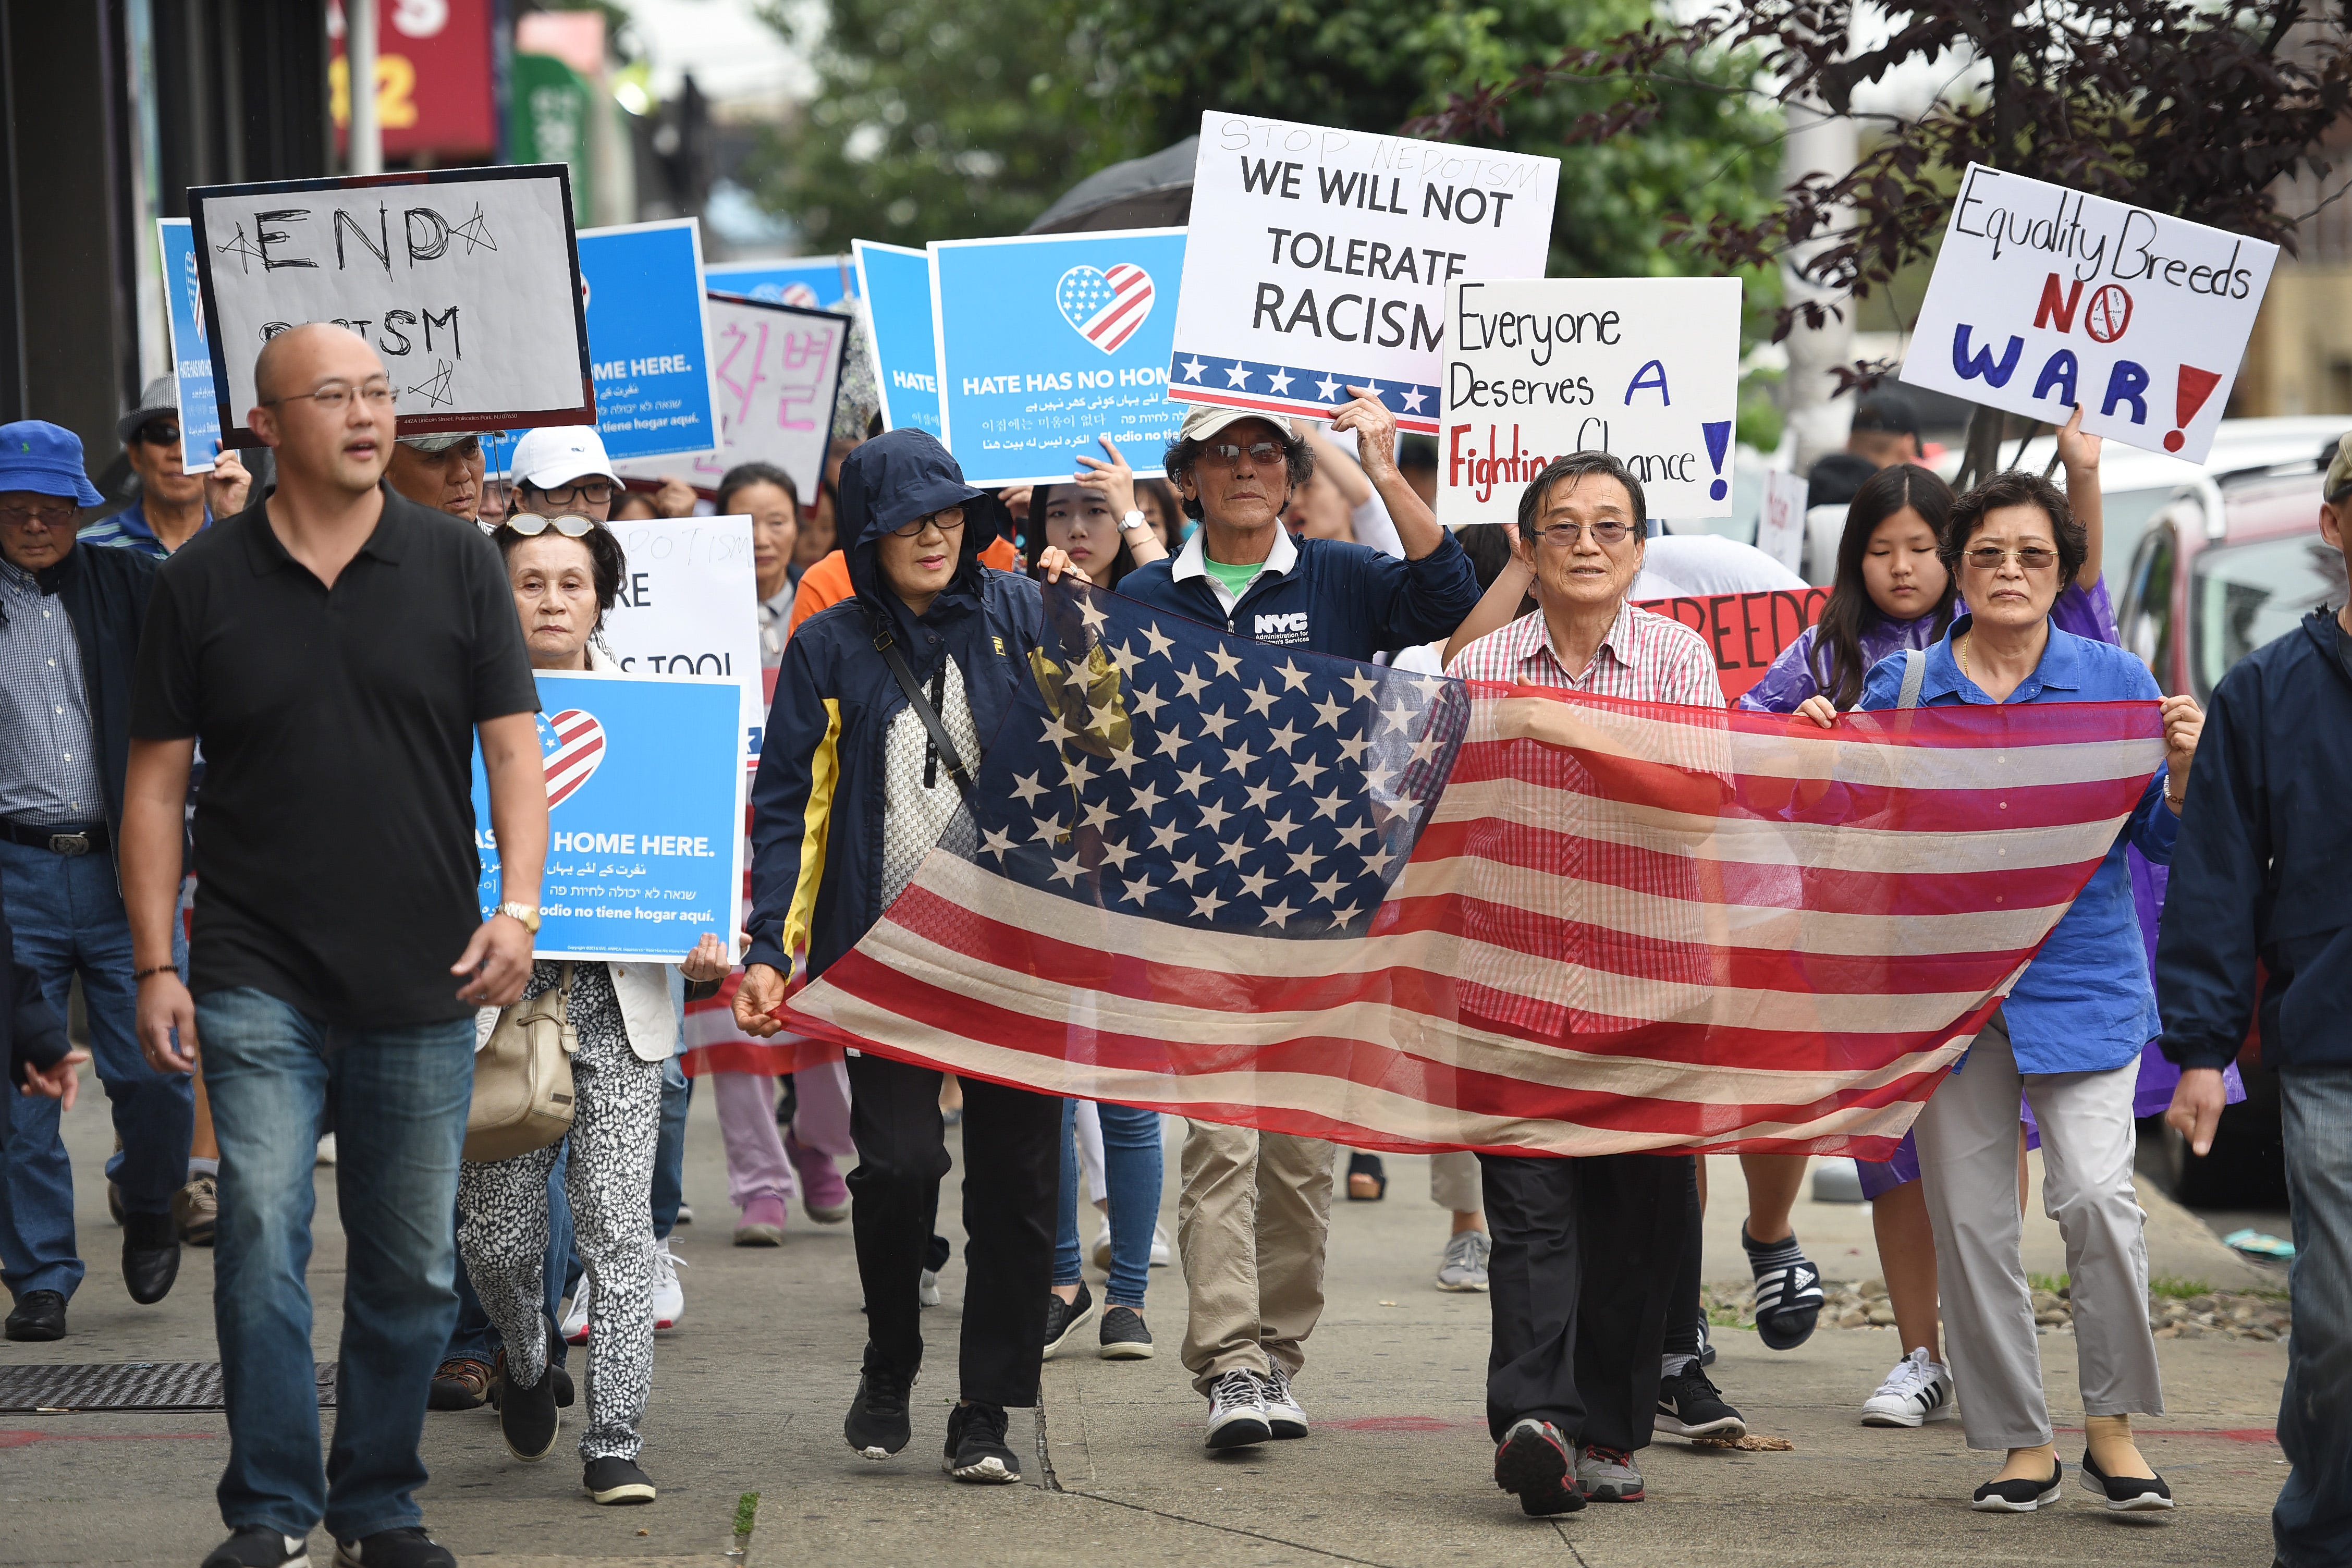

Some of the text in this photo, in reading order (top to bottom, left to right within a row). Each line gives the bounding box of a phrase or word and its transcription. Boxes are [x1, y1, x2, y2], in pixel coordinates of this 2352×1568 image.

[1221, 120, 1349, 163] STOP
[1241, 156, 1513, 228] WE WILL NOT
[254, 200, 449, 282] END
[1956, 167, 2252, 300] Equality Breeds
[1267, 227, 1466, 288] TOLERATE
[2034, 272, 2134, 344] NO
[1459, 283, 1621, 366] Everyone
[630, 354, 692, 377] HERE.
[892, 370, 937, 394] HATE
[963, 375, 1022, 396] HATE
[1026, 372, 1073, 392] HAS
[1077, 370, 1114, 389] NO
[1450, 359, 1671, 411] Deserves A
[633, 418, 668, 431] hogar
[982, 419, 994, 433] 이
[1121, 414, 1136, 424] פה
[1114, 430, 1143, 443] odio
[1145, 432, 1161, 441] no
[1162, 428, 1181, 439] tie
[1449, 423, 1563, 503] Fightin
[613, 528, 753, 569] POTISM
[1255, 612, 1308, 634] NYC
[554, 832, 635, 855] HOME
[641, 835, 715, 858] HERE.
[549, 885, 697, 901] שנאה לא יכולה לחיות פה
[539, 903, 715, 925] odio no tiene hogar aquí.
